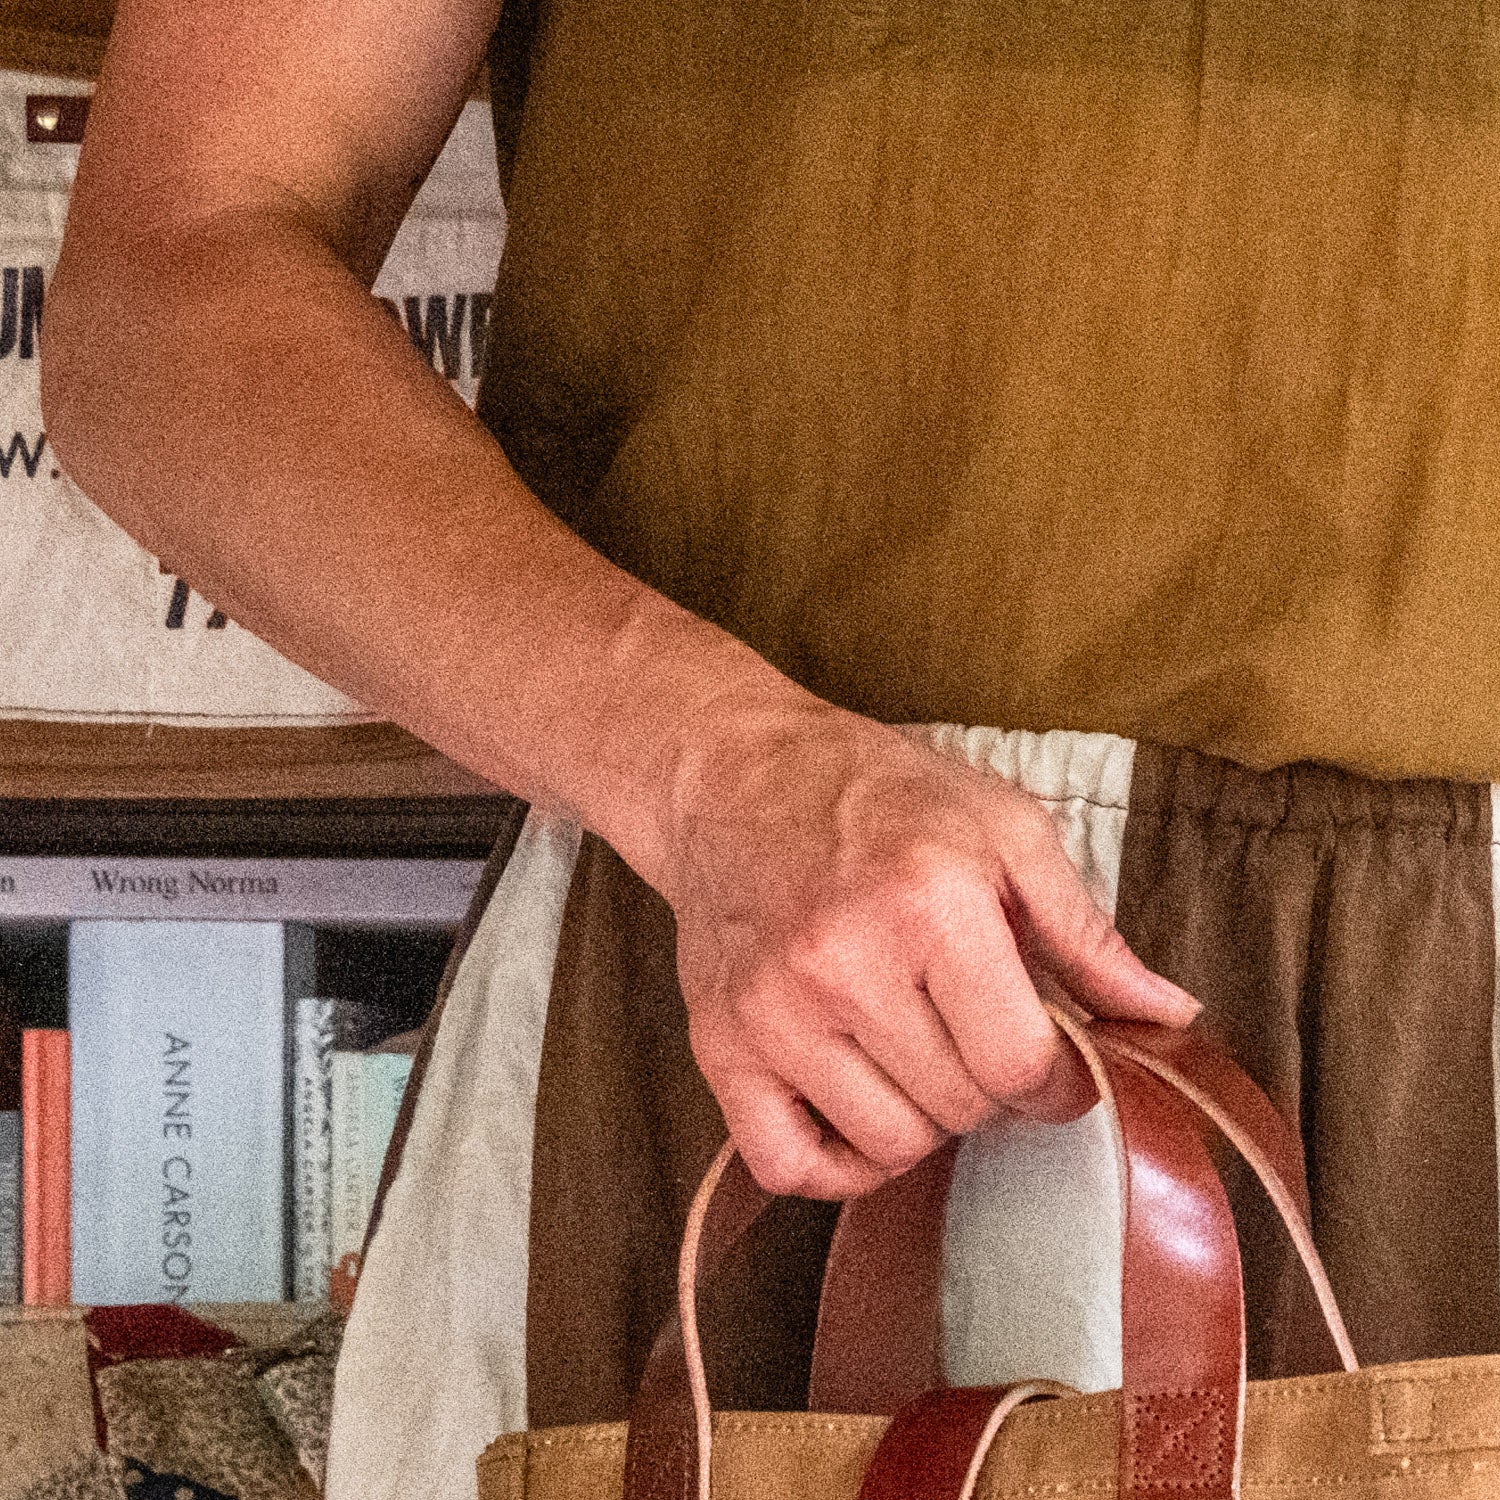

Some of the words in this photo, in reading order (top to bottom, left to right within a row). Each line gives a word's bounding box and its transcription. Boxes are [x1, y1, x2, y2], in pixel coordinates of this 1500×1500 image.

[91, 869, 179, 900] Wrong
[188, 869, 279, 895] Norma
[163, 1029, 194, 1136] ANNE
